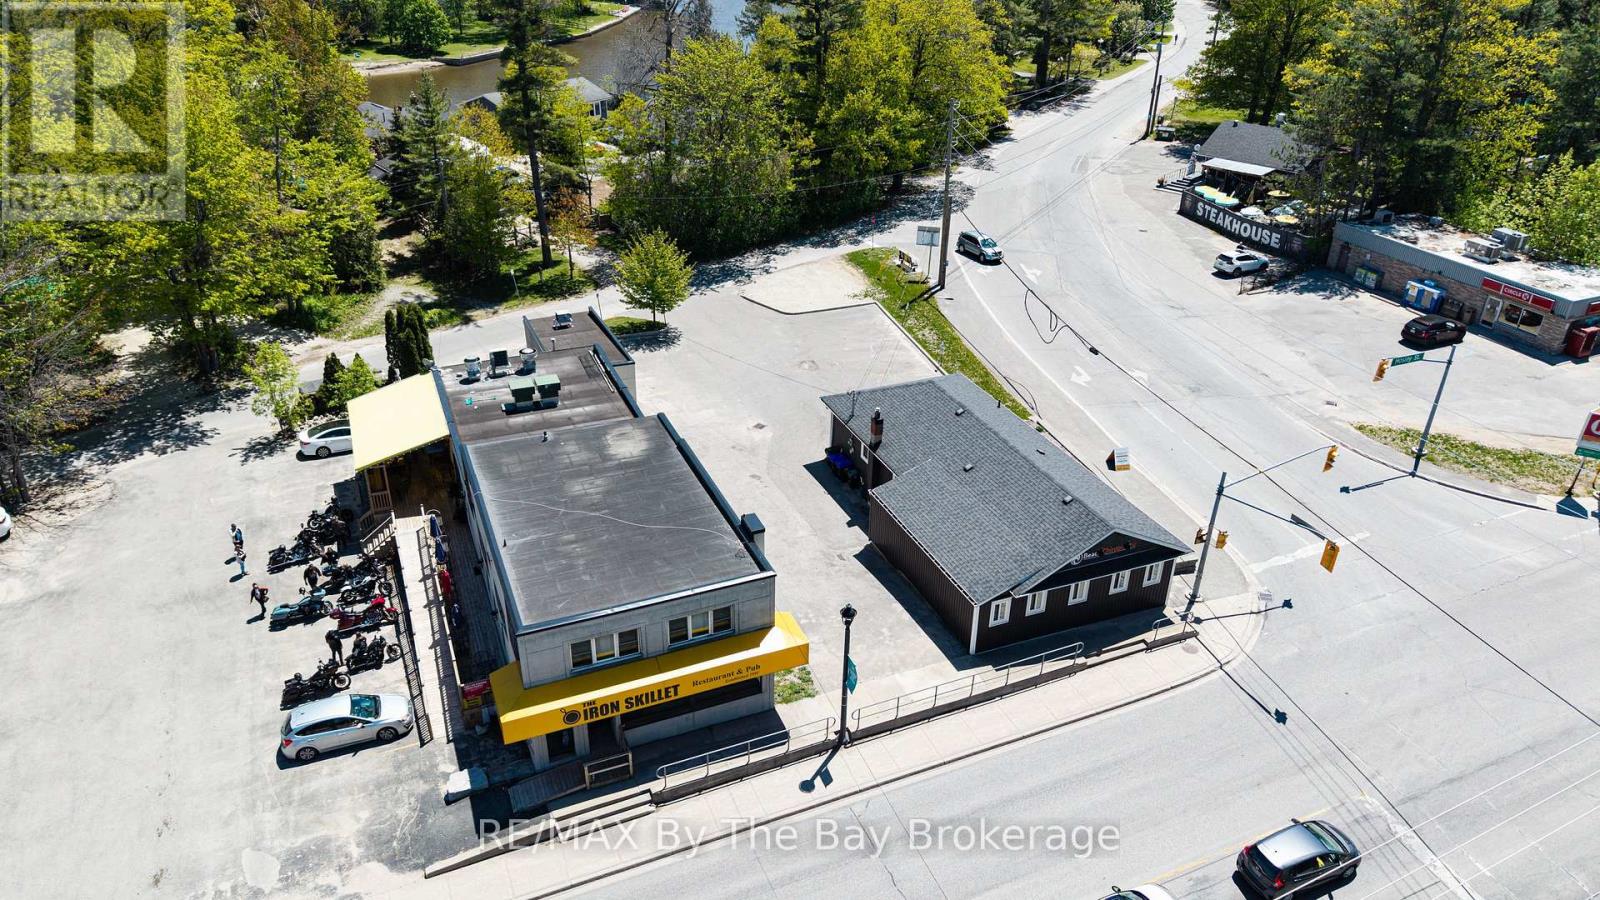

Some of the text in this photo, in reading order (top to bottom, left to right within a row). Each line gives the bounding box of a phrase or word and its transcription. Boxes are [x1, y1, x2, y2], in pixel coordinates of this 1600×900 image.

[1196, 201, 1281, 249] STEAKHOUSE
[1503, 286, 1522, 298] CIRCLE
[692, 670, 734, 687] Restaurant
[736, 667, 742, 675] &
[746, 663, 761, 673] Pub
[583, 684, 680, 721] IRON SKILLET
[583, 700, 596, 708] THE
